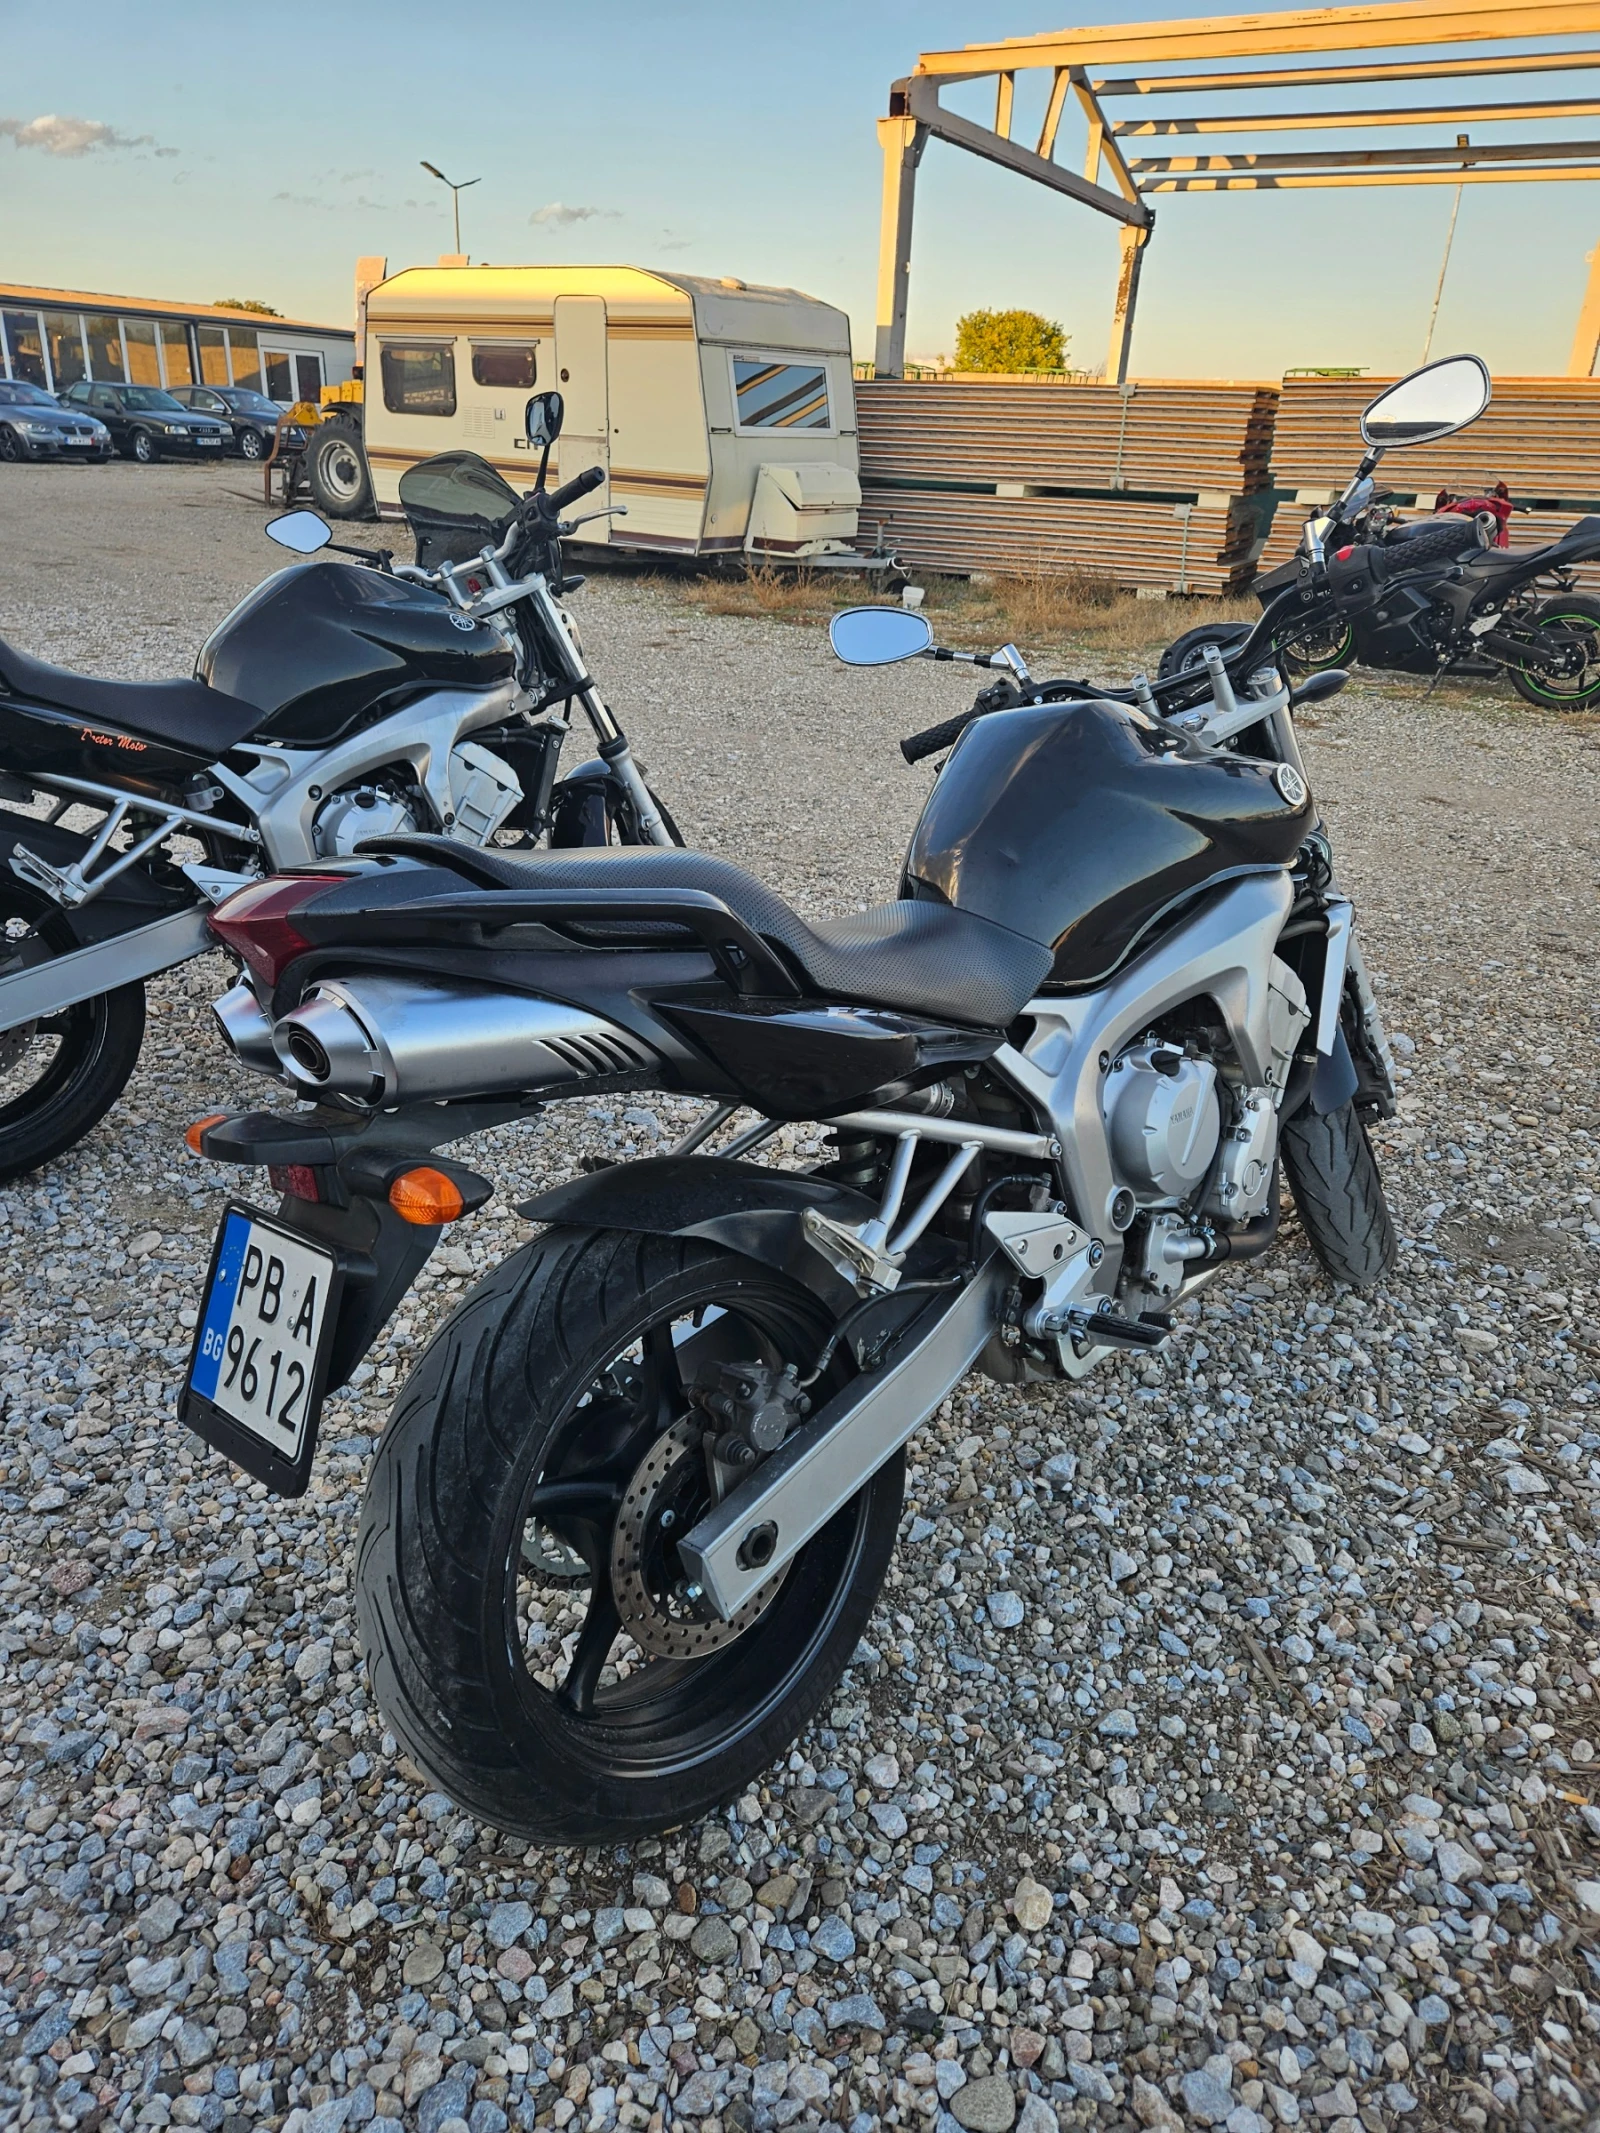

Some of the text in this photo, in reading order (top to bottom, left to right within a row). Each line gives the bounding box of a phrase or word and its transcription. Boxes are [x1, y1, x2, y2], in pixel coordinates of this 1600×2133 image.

[1170, 1106, 1194, 1125] YAMAHA
[237, 1244, 317, 1347] PB A
[202, 1327, 223, 1362] BG
[223, 1325, 305, 1433] 9612
